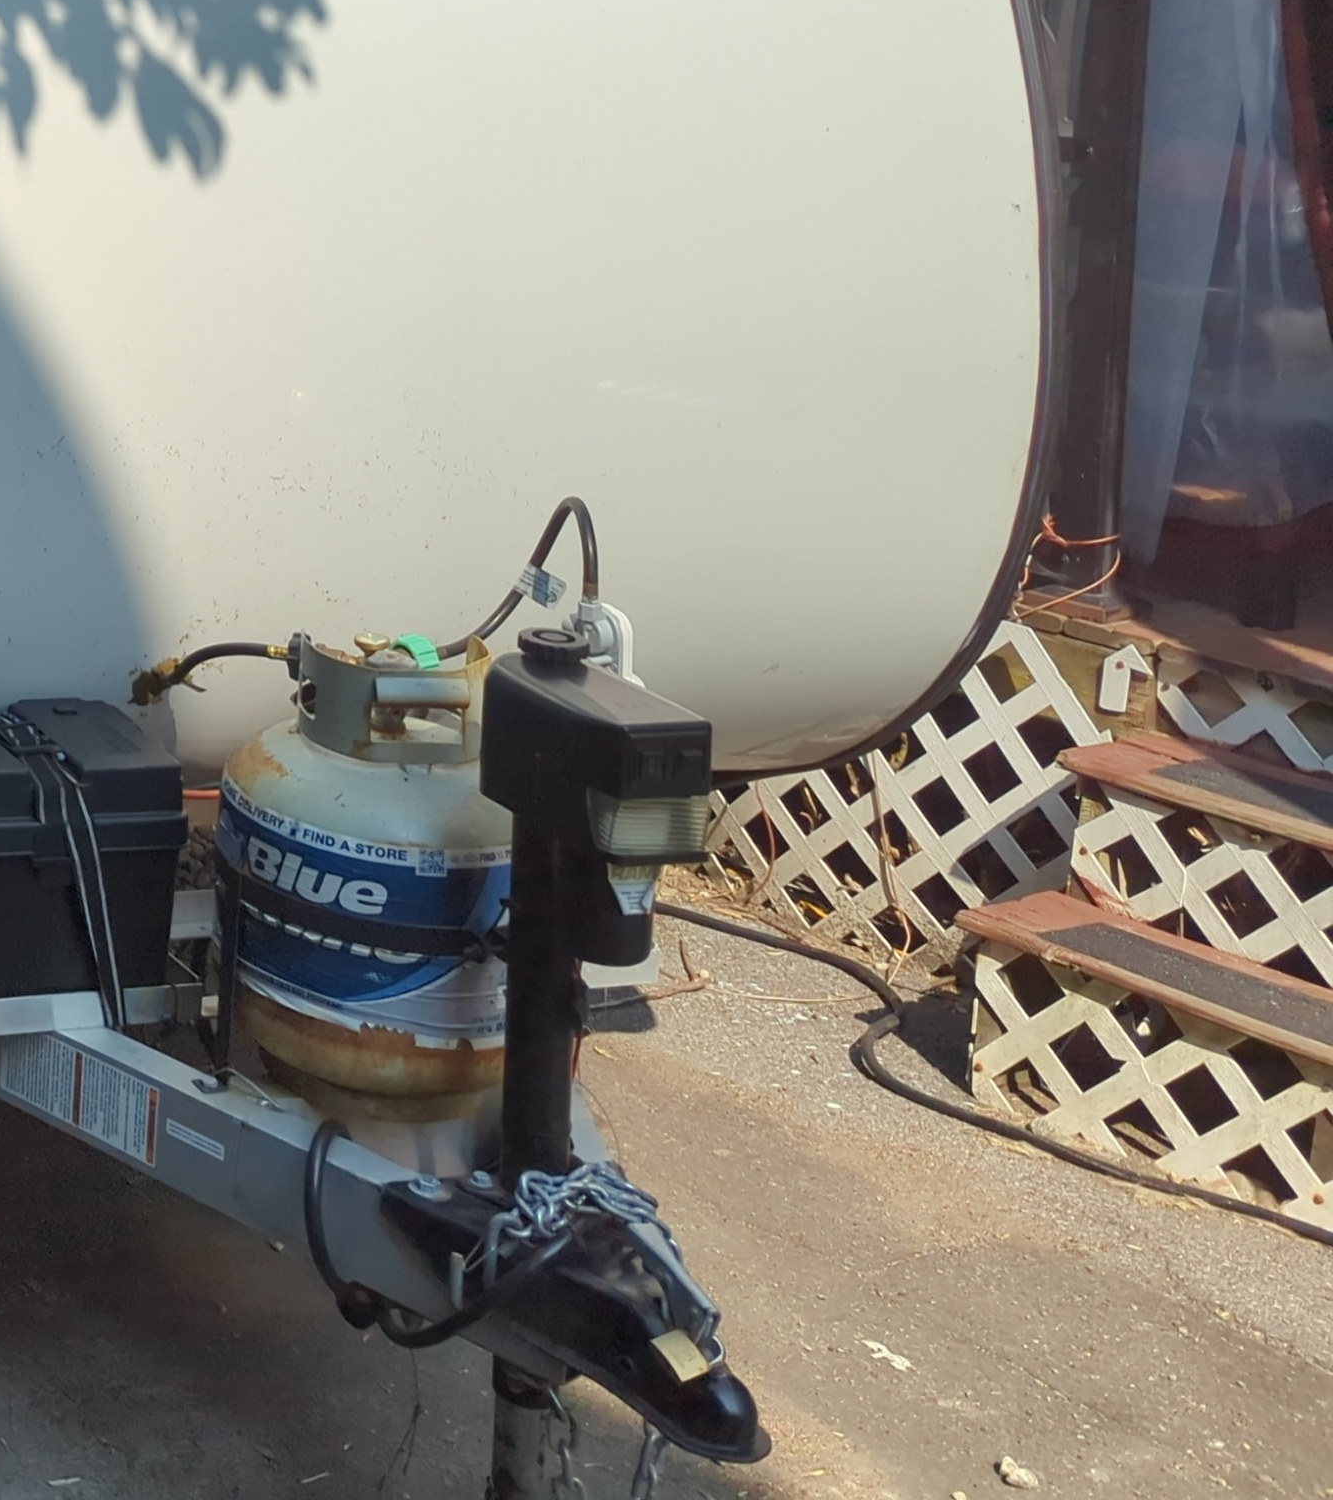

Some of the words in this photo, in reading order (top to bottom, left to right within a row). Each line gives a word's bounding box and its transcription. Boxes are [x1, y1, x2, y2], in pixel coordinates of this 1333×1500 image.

[238, 795, 285, 829] DELIVERY
[302, 828, 336, 848] FIND
[340, 841, 350, 852] A
[355, 843, 408, 862] STORE
[247, 836, 388, 915] Blue
